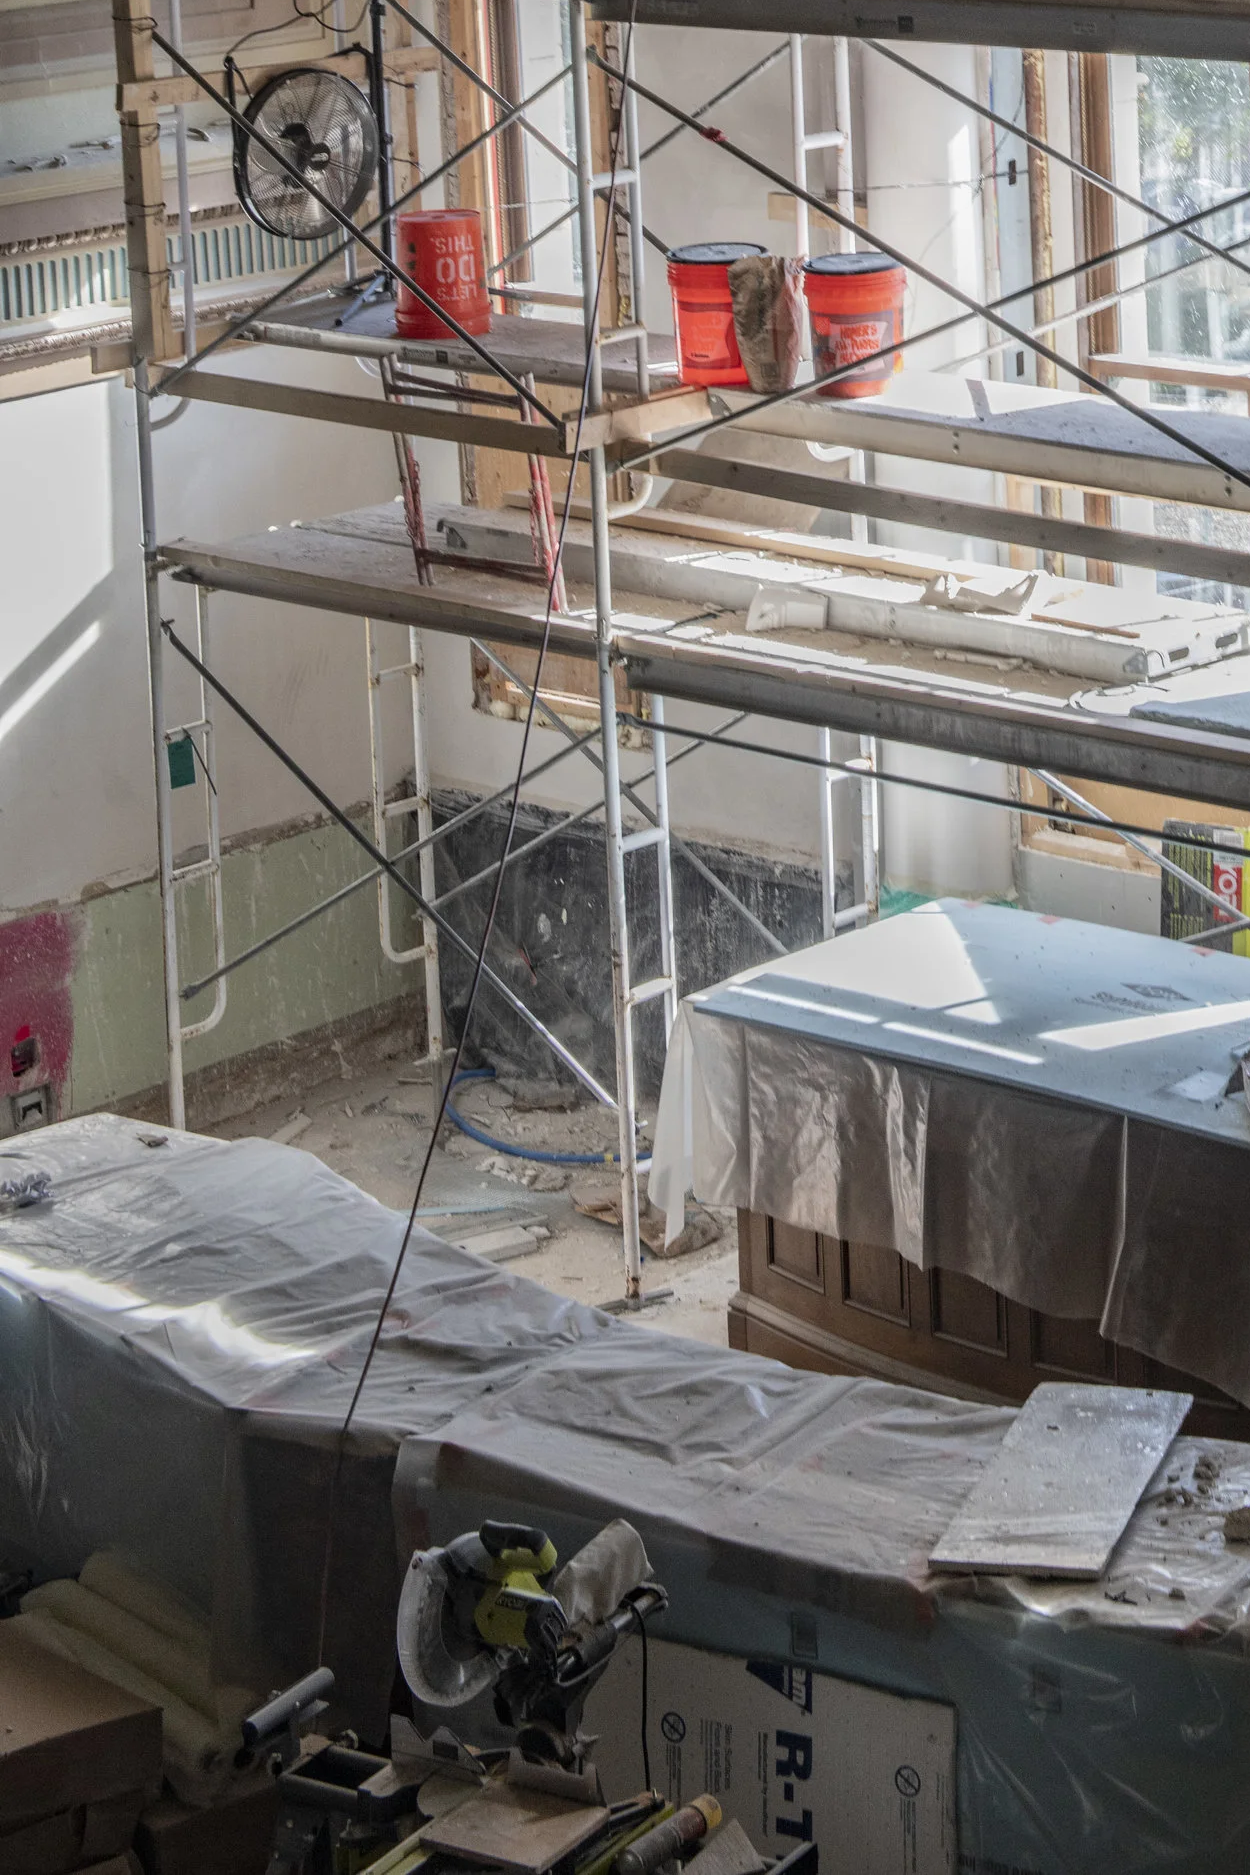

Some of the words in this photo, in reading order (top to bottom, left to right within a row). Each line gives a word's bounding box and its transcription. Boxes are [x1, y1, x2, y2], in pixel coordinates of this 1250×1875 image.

[430, 234, 475, 254] THIS.
[436, 254, 476, 284] DO
[775, 1729, 813, 1860] R-T
